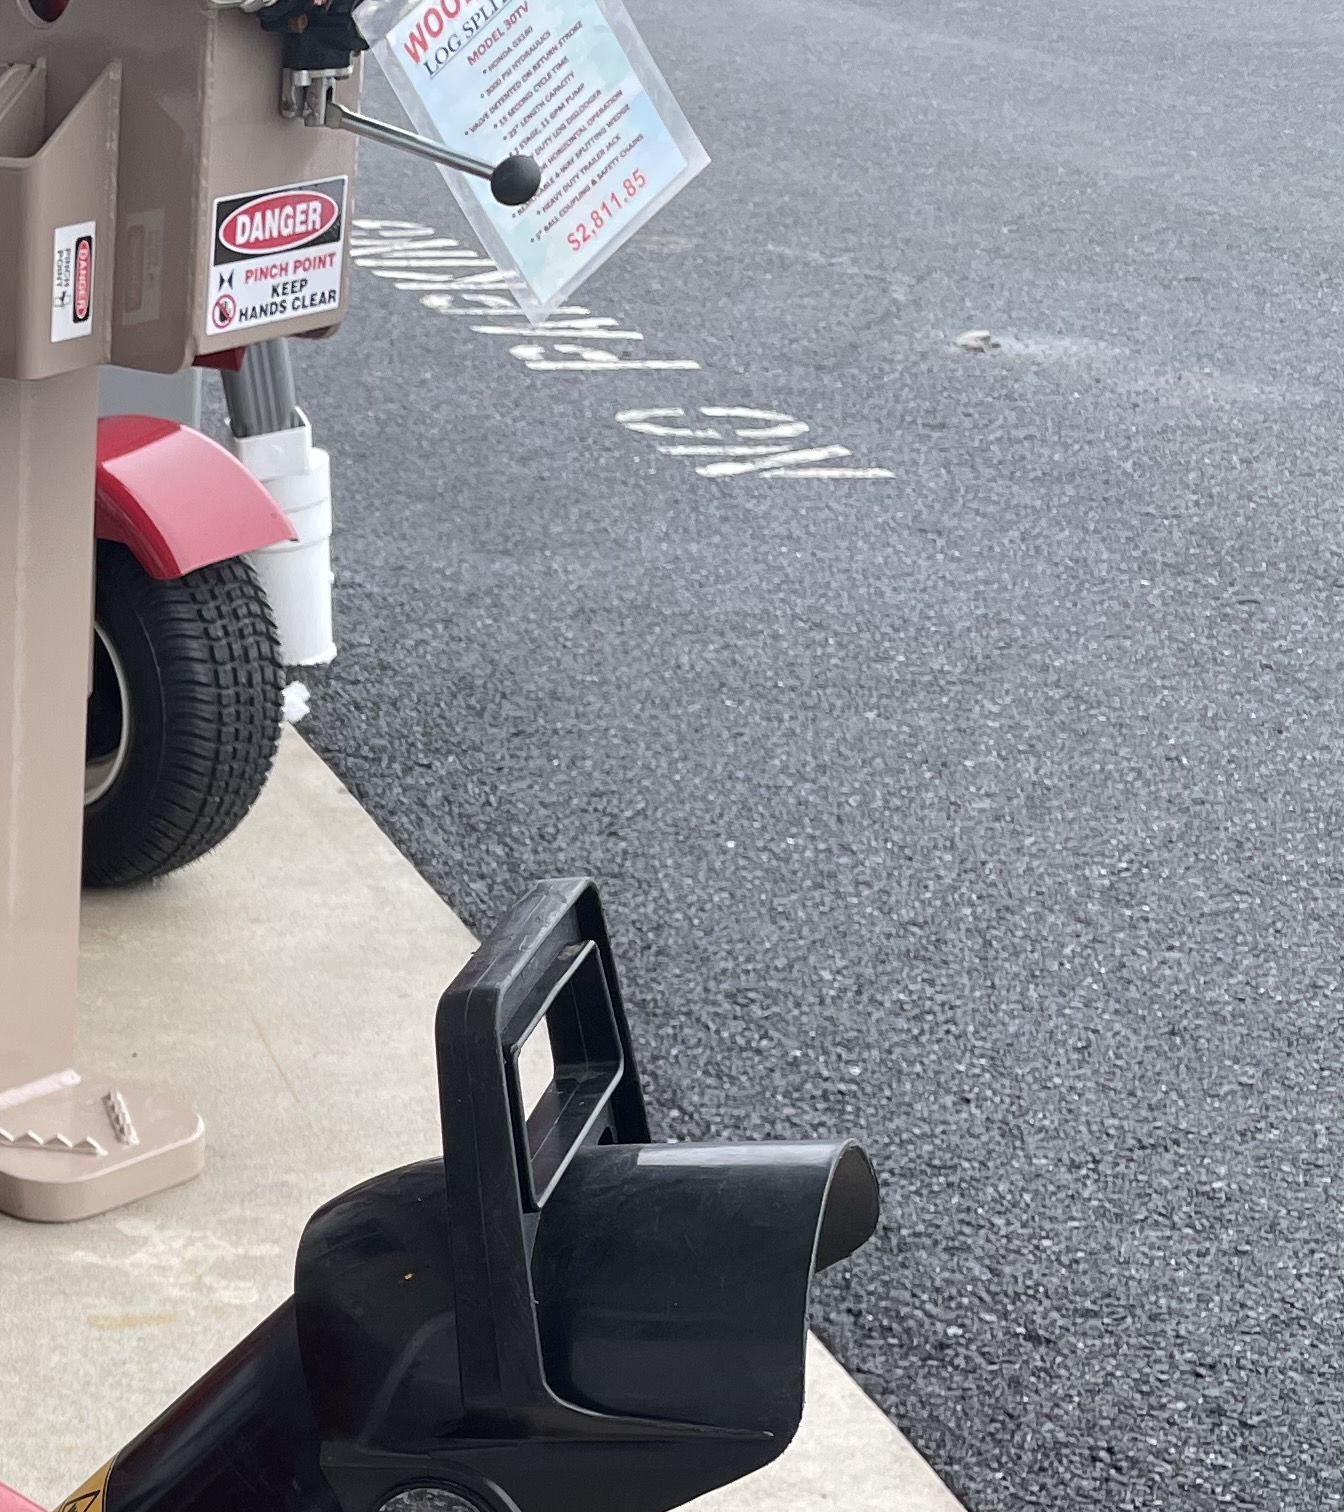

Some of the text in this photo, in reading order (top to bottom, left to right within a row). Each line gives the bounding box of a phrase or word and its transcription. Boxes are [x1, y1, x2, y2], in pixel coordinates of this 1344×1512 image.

[404, 0, 475, 65] WOO
[423, 0, 510, 75] LOG SPLI
[467, 0, 530, 66] MODEL 30TV
[487, 46, 513, 72] HONDA
[469, 111, 491, 133] VALVE
[558, 20, 583, 48] STROKE
[507, 90, 534, 118] SECOND
[533, 71, 553, 93] CYCLE
[551, 55, 570, 76] TIME
[520, 99, 546, 128] LENGTH
[545, 70, 575, 103] CAPACITY
[565, 82, 586, 105] PUMP
[586, 88, 624, 127] OPERATION
[534, 134, 554, 156] DUTY
[551, 122, 567, 139] LOG
[541, 132, 622, 214] HEAVY DUTY TRAILER JACK
[543, 215, 560, 233] BALL
[558, 183, 591, 218] COUPLING
[596, 154, 620, 181] SAFETY
[235, 200, 322, 246] DANGER
[77, 249, 90, 309] DANGER
[244, 251, 338, 285] PINCH POINT
[270, 277, 309, 299] KEEP
[238, 288, 338, 323] HANDS CLEAR
[615, 405, 895, 479] NO
